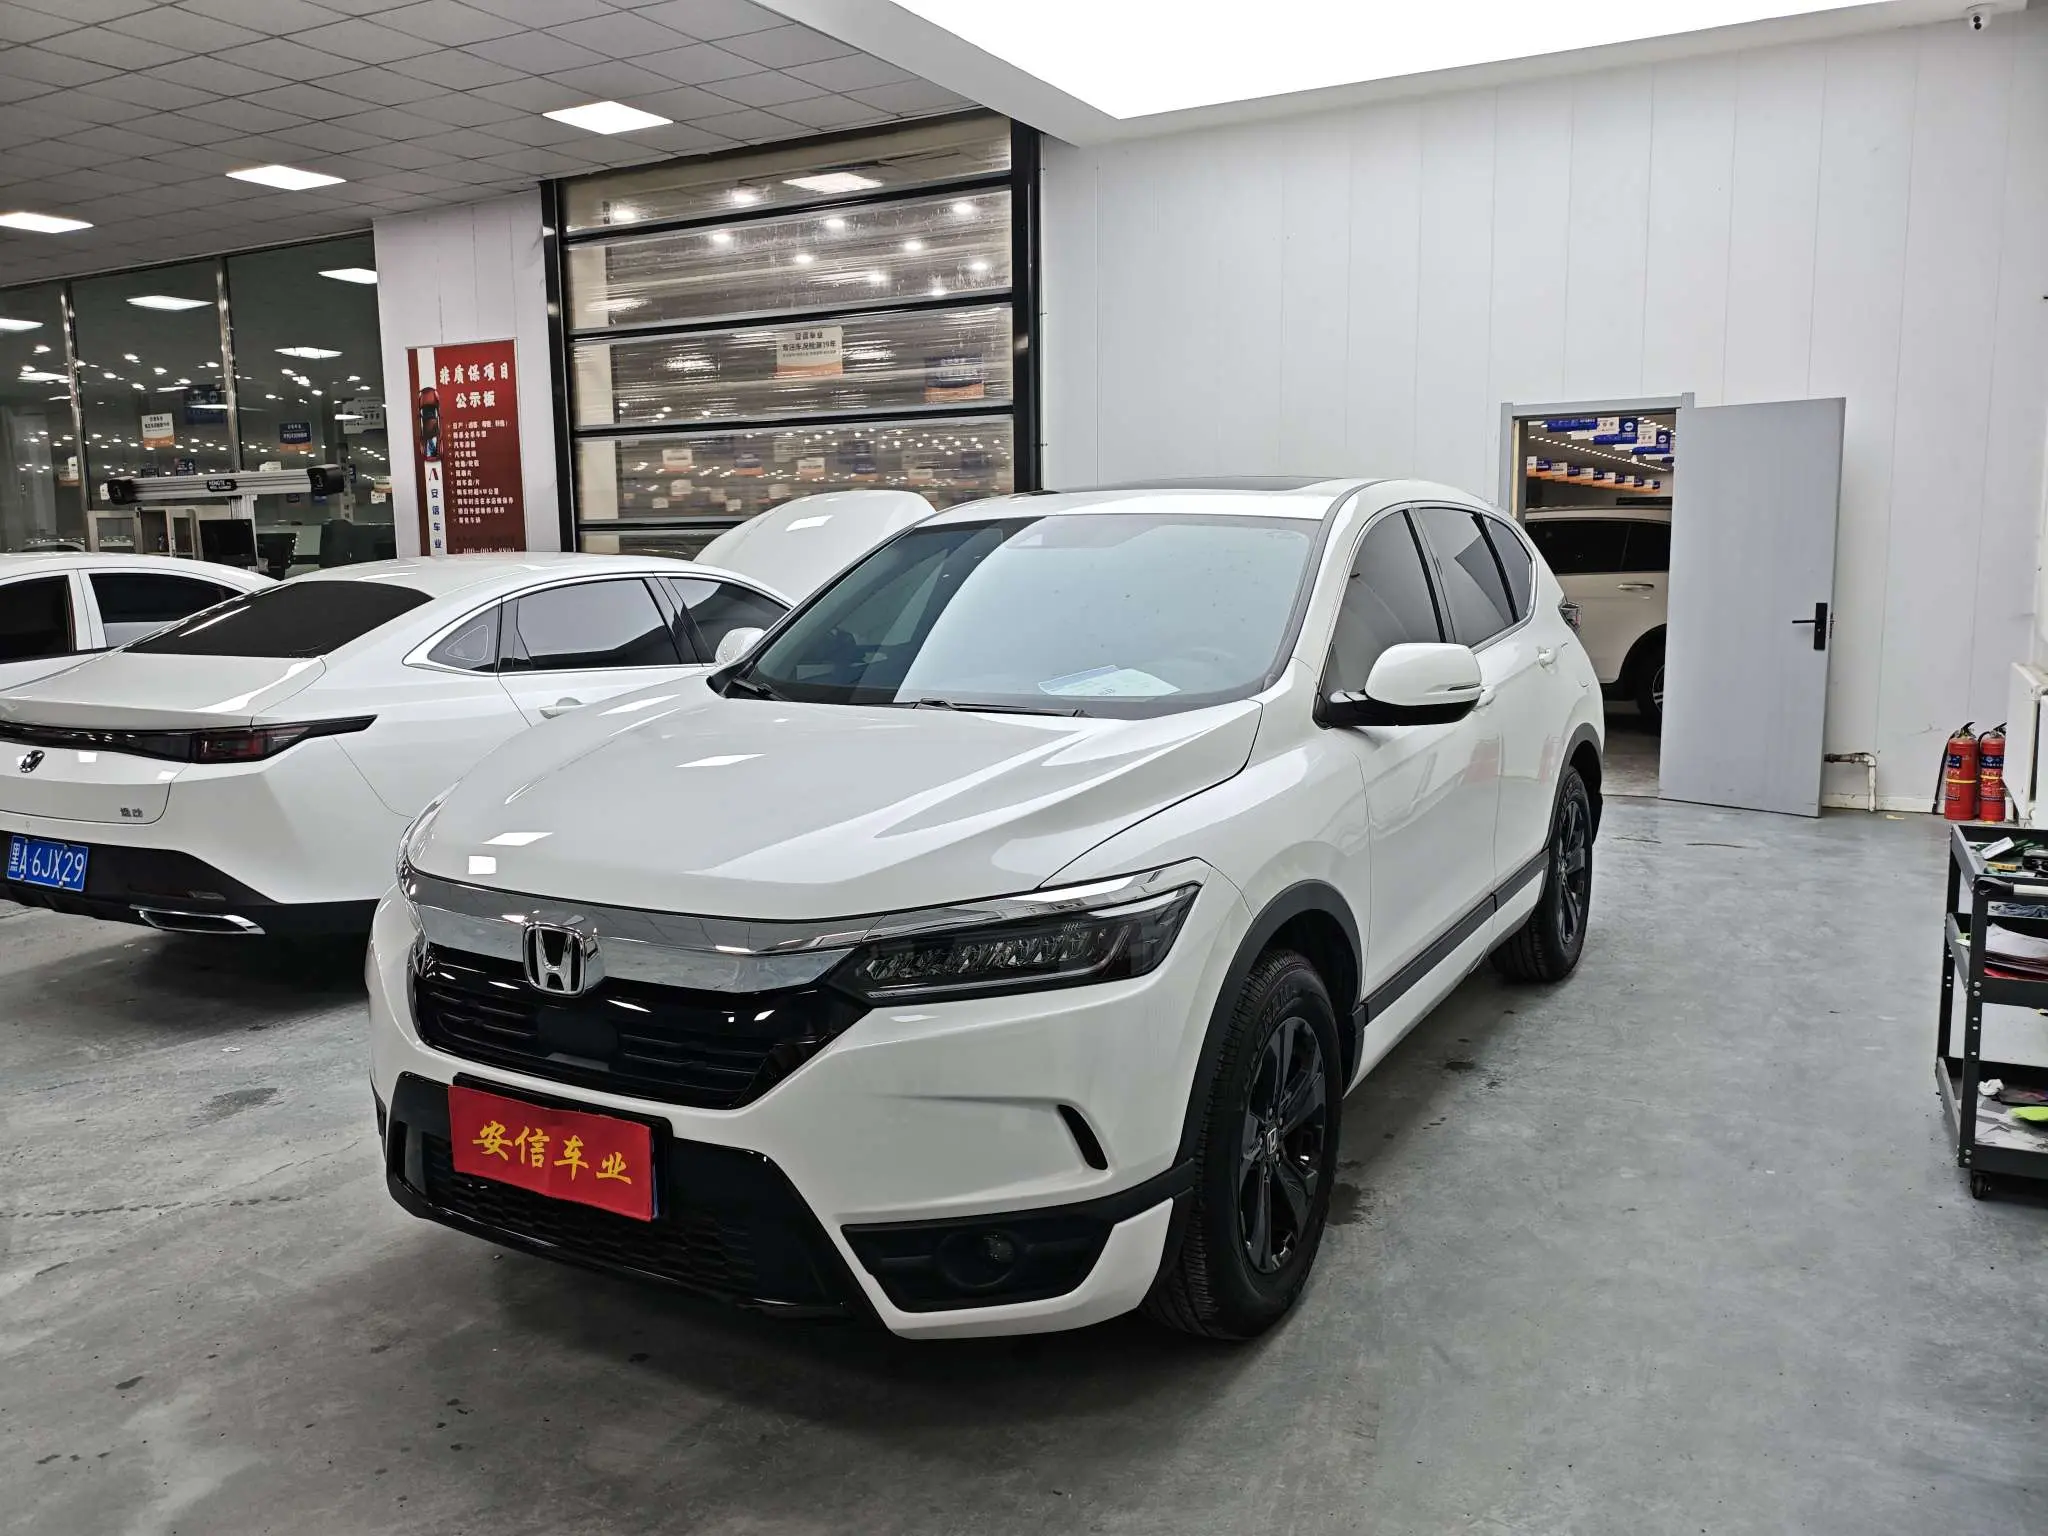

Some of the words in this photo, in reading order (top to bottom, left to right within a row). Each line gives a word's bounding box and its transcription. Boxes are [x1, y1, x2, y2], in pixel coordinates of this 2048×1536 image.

[439, 361, 509, 386] 非质保项目
[455, 390, 496, 409] 公示板
[430, 488, 442, 549] 安信车业
[472, 1119, 633, 1186] 安信车业
